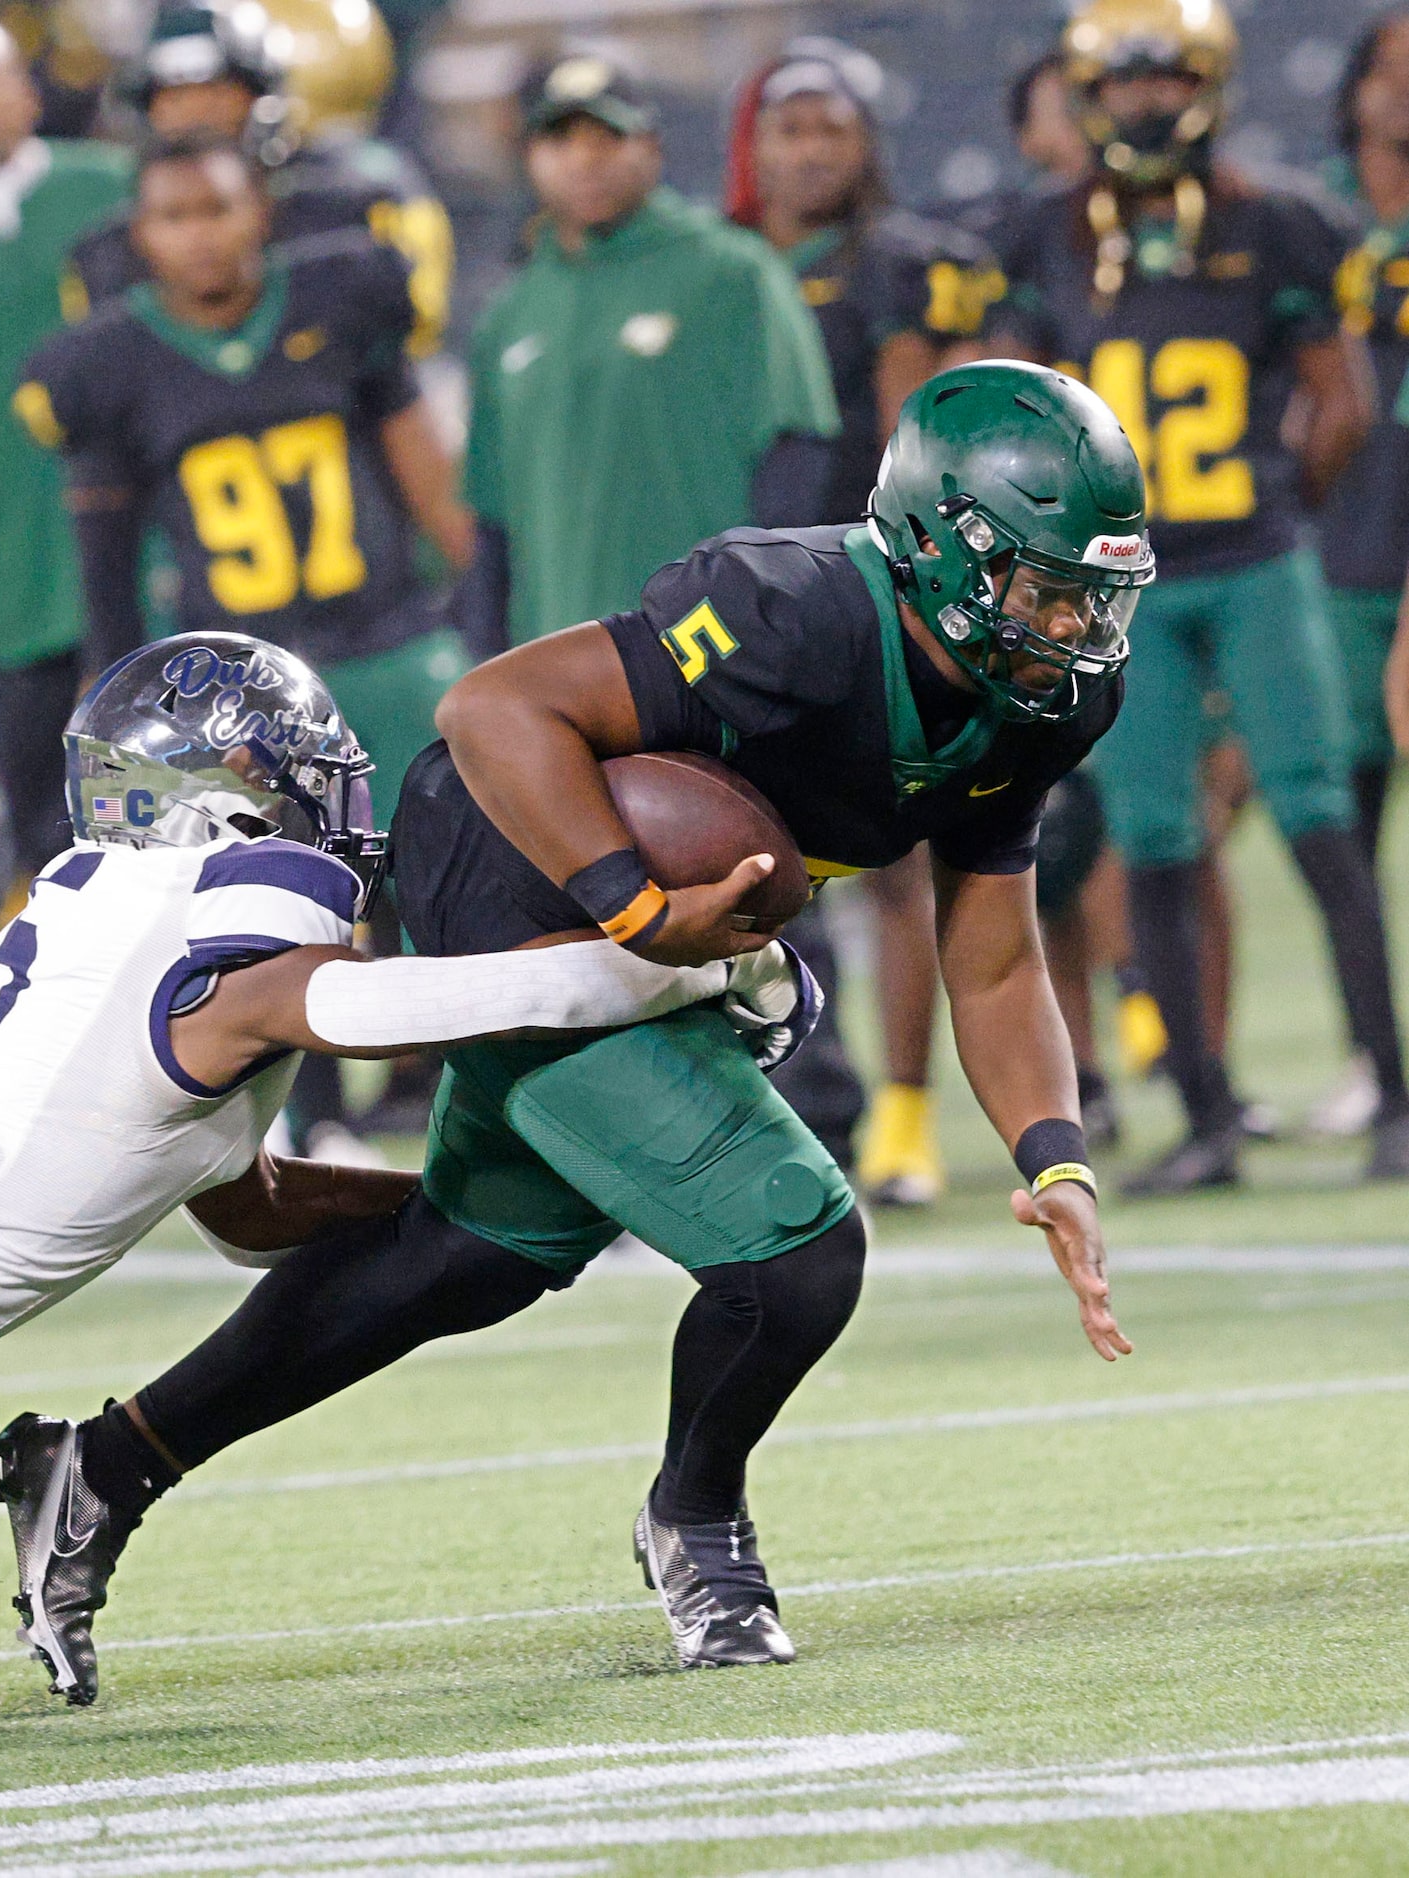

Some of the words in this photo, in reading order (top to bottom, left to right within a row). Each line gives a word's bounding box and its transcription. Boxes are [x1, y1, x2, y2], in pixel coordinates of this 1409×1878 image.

[178, 413, 367, 614] 97
[1099, 541, 1140, 558] Riddell
[659, 596, 741, 687] 5
[163, 647, 284, 698] Dub
[204, 688, 312, 750] East
[126, 788, 155, 827] C
